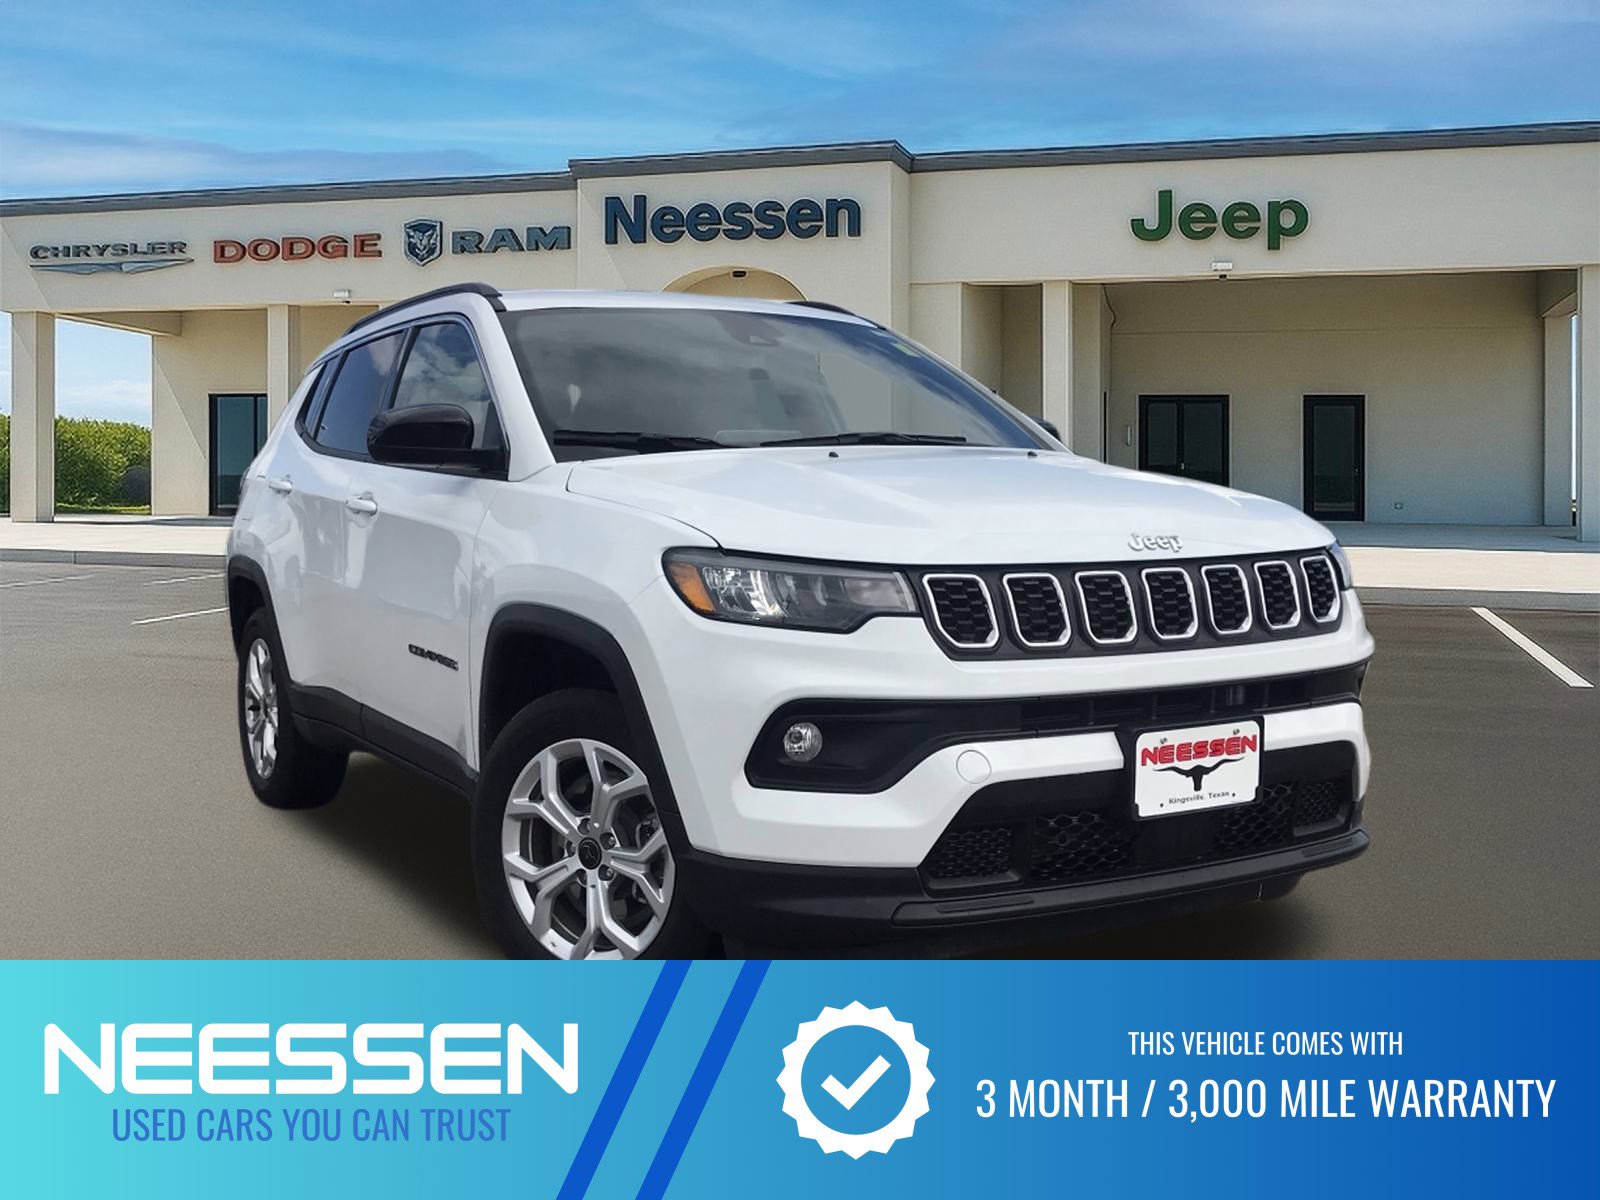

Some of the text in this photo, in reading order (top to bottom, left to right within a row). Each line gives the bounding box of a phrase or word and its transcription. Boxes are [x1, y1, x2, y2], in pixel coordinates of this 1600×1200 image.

[604, 195, 862, 245] Neessen
[1130, 189, 1309, 250] Jeep
[29, 241, 188, 261] CHRYSLER
[213, 233, 382, 264] DODGE
[451, 226, 571, 255] RAM
[1127, 532, 1184, 553] Jeep
[1140, 734, 1258, 767] NEESSEN
